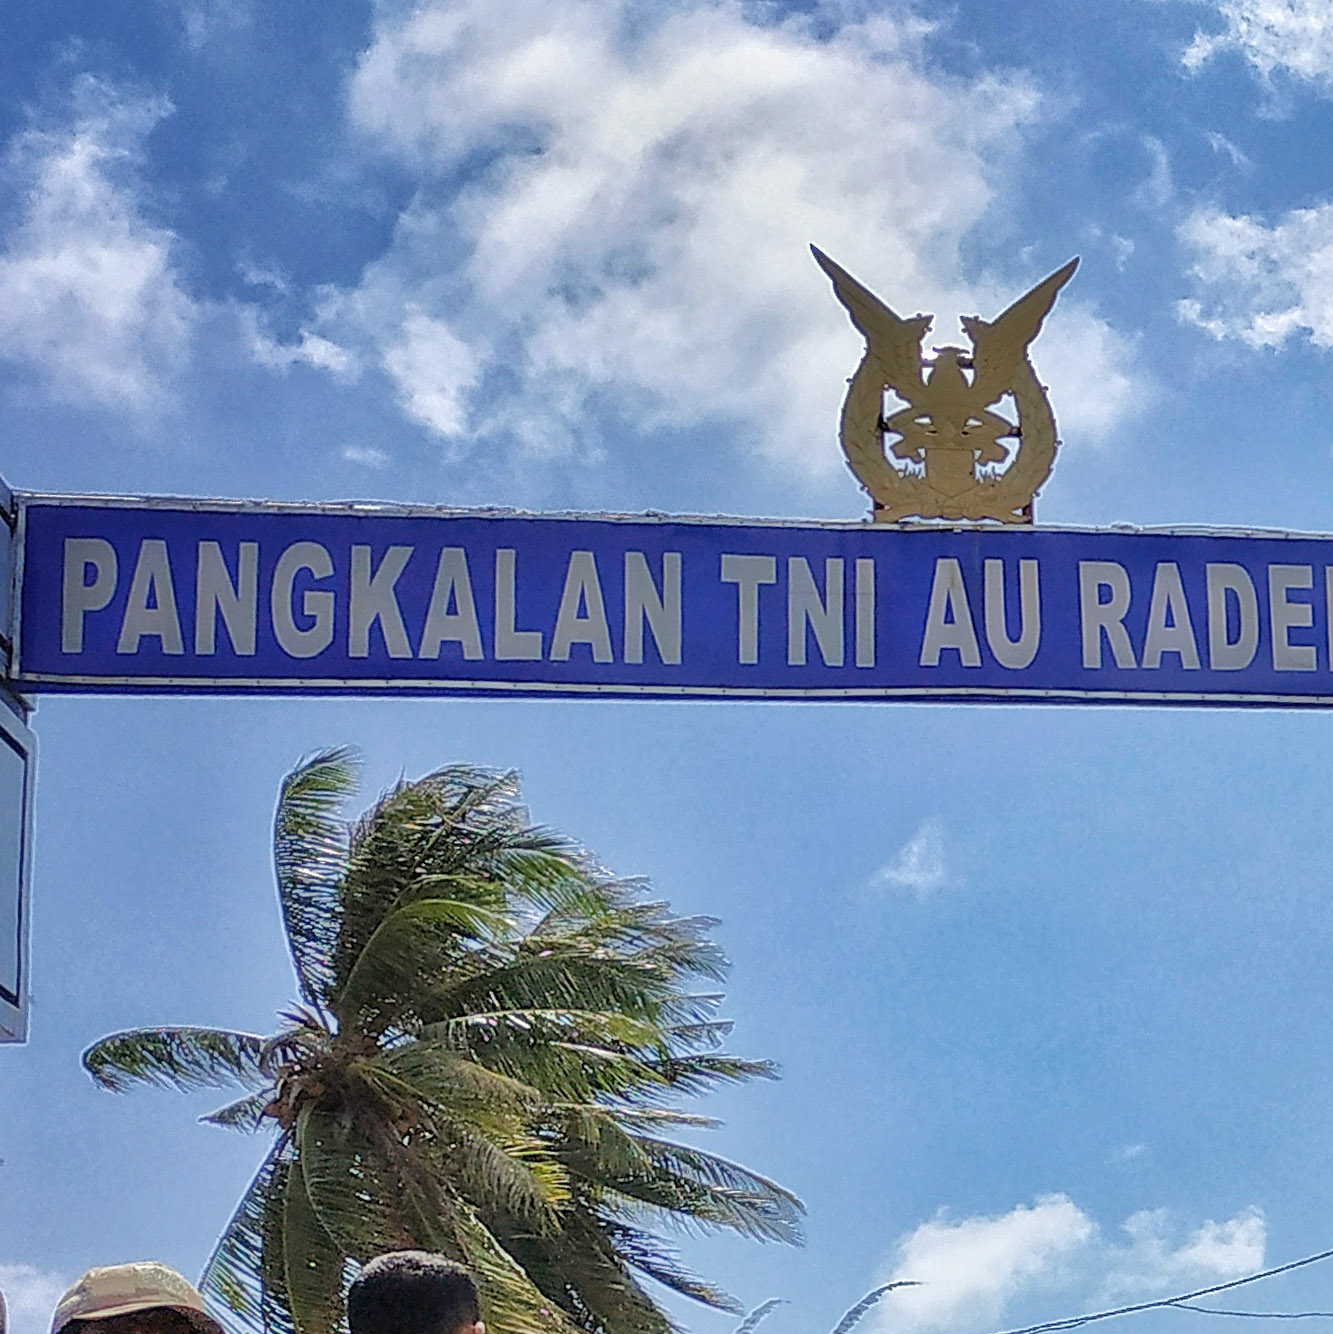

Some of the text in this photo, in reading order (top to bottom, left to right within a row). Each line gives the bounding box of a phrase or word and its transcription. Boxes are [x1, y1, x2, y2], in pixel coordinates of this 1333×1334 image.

[61, 537, 683, 665] PANGKALAN
[721, 554, 876, 669] TNI
[919, 557, 1042, 671] AU
